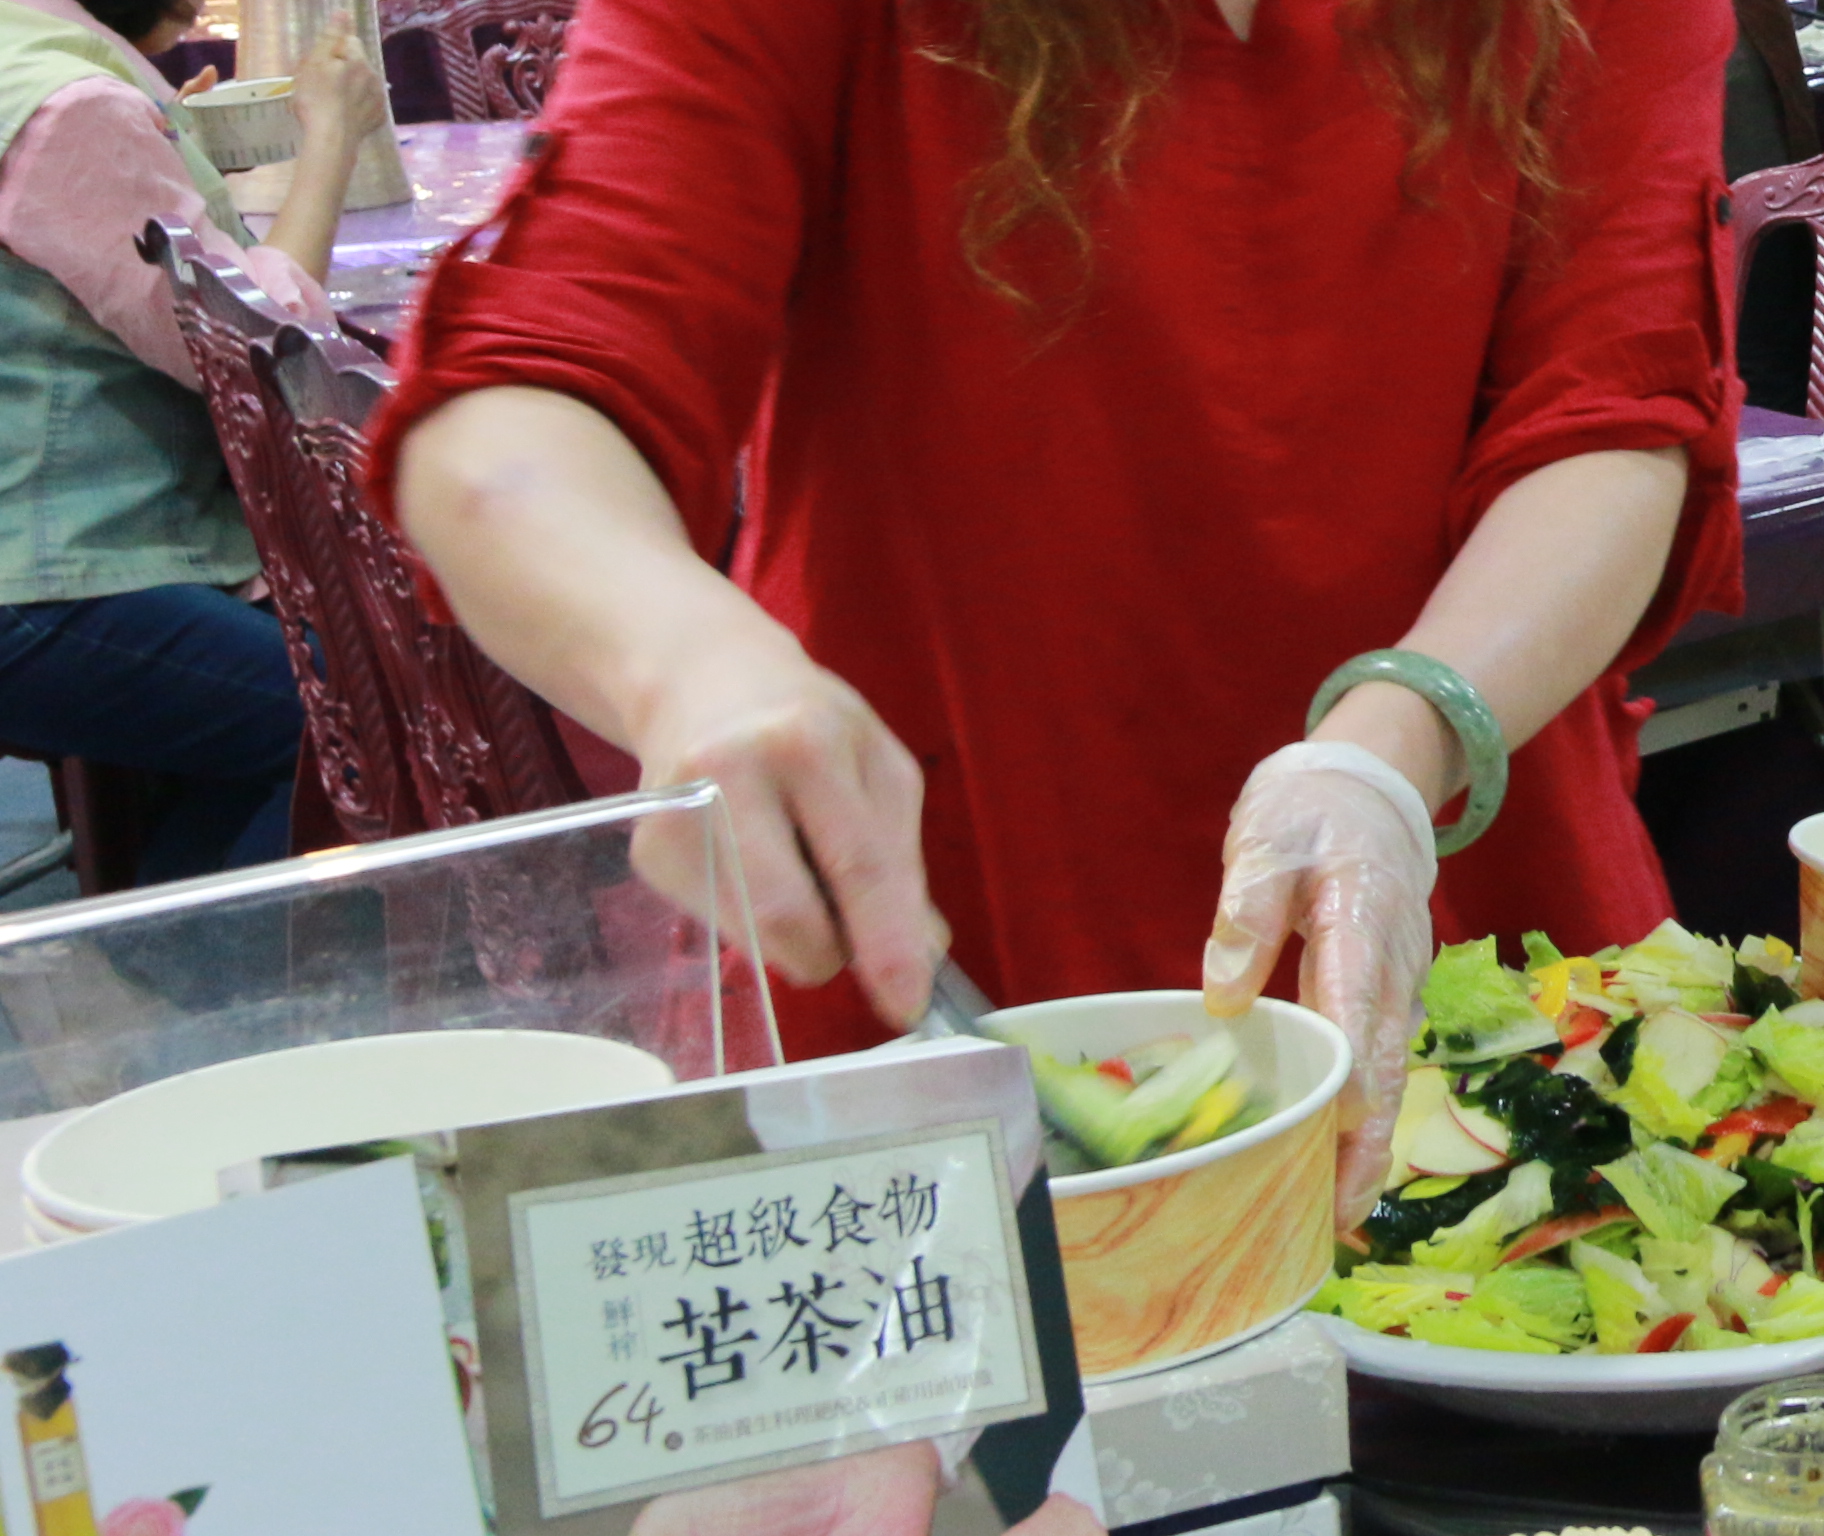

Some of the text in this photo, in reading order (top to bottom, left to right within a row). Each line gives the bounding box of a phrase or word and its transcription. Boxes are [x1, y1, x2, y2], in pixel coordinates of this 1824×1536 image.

[590, 1174, 938, 1280] 發現超級食物
[658, 1255, 954, 1402] 苦茶油
